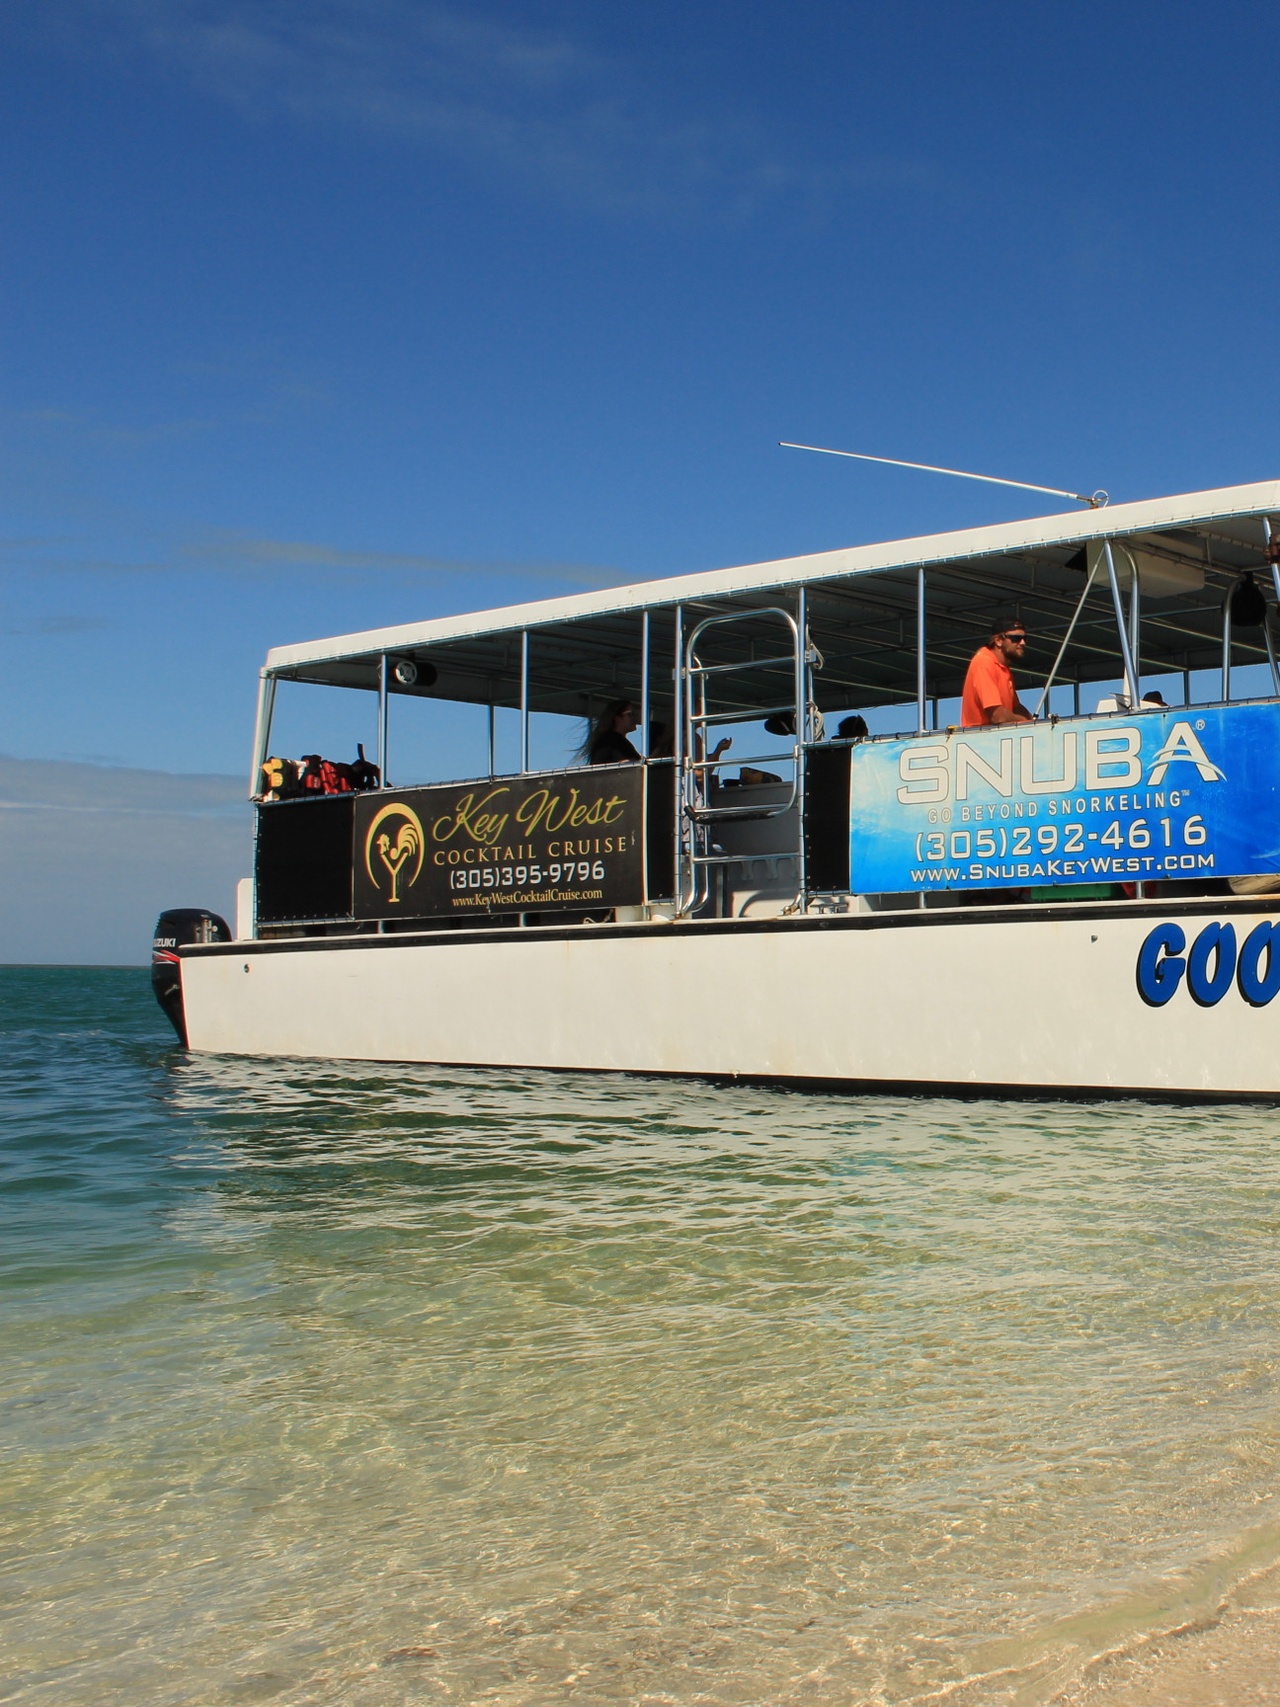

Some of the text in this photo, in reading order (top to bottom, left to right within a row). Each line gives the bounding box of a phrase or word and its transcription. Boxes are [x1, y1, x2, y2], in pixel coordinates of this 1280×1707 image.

[432, 787, 627, 845] Key West
[928, 808, 952, 824] GO
[961, 802, 1038, 822] BEYOND
[433, 836, 626, 866] COCKTAIL CRUISE
[914, 815, 1208, 863] (305)292-4616
[450, 860, 605, 890] (305)395-9796
[452, 888, 604, 908] www.KeyWestCocktailCruise.com
